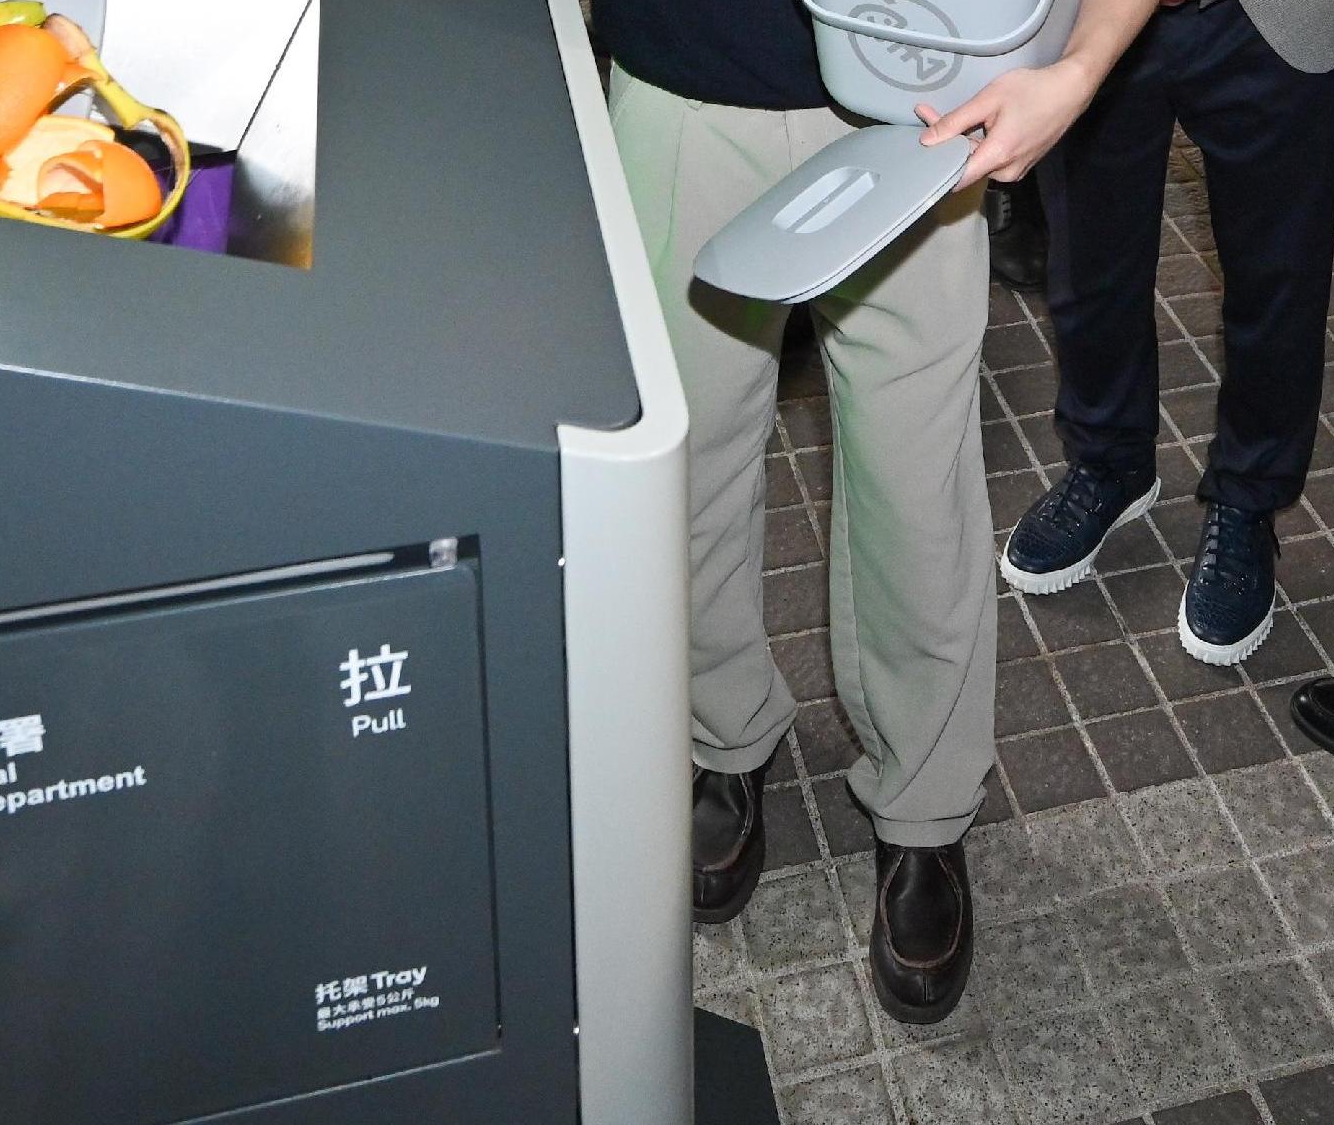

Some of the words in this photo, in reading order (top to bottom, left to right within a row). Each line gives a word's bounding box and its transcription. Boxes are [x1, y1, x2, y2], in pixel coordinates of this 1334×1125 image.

[339, 644, 412, 707] 拉
[352, 708, 407, 738] Pull
[315, 975, 368, 1005] 托架
[369, 966, 427, 990] Tray
[317, 1010, 375, 1032] Support
